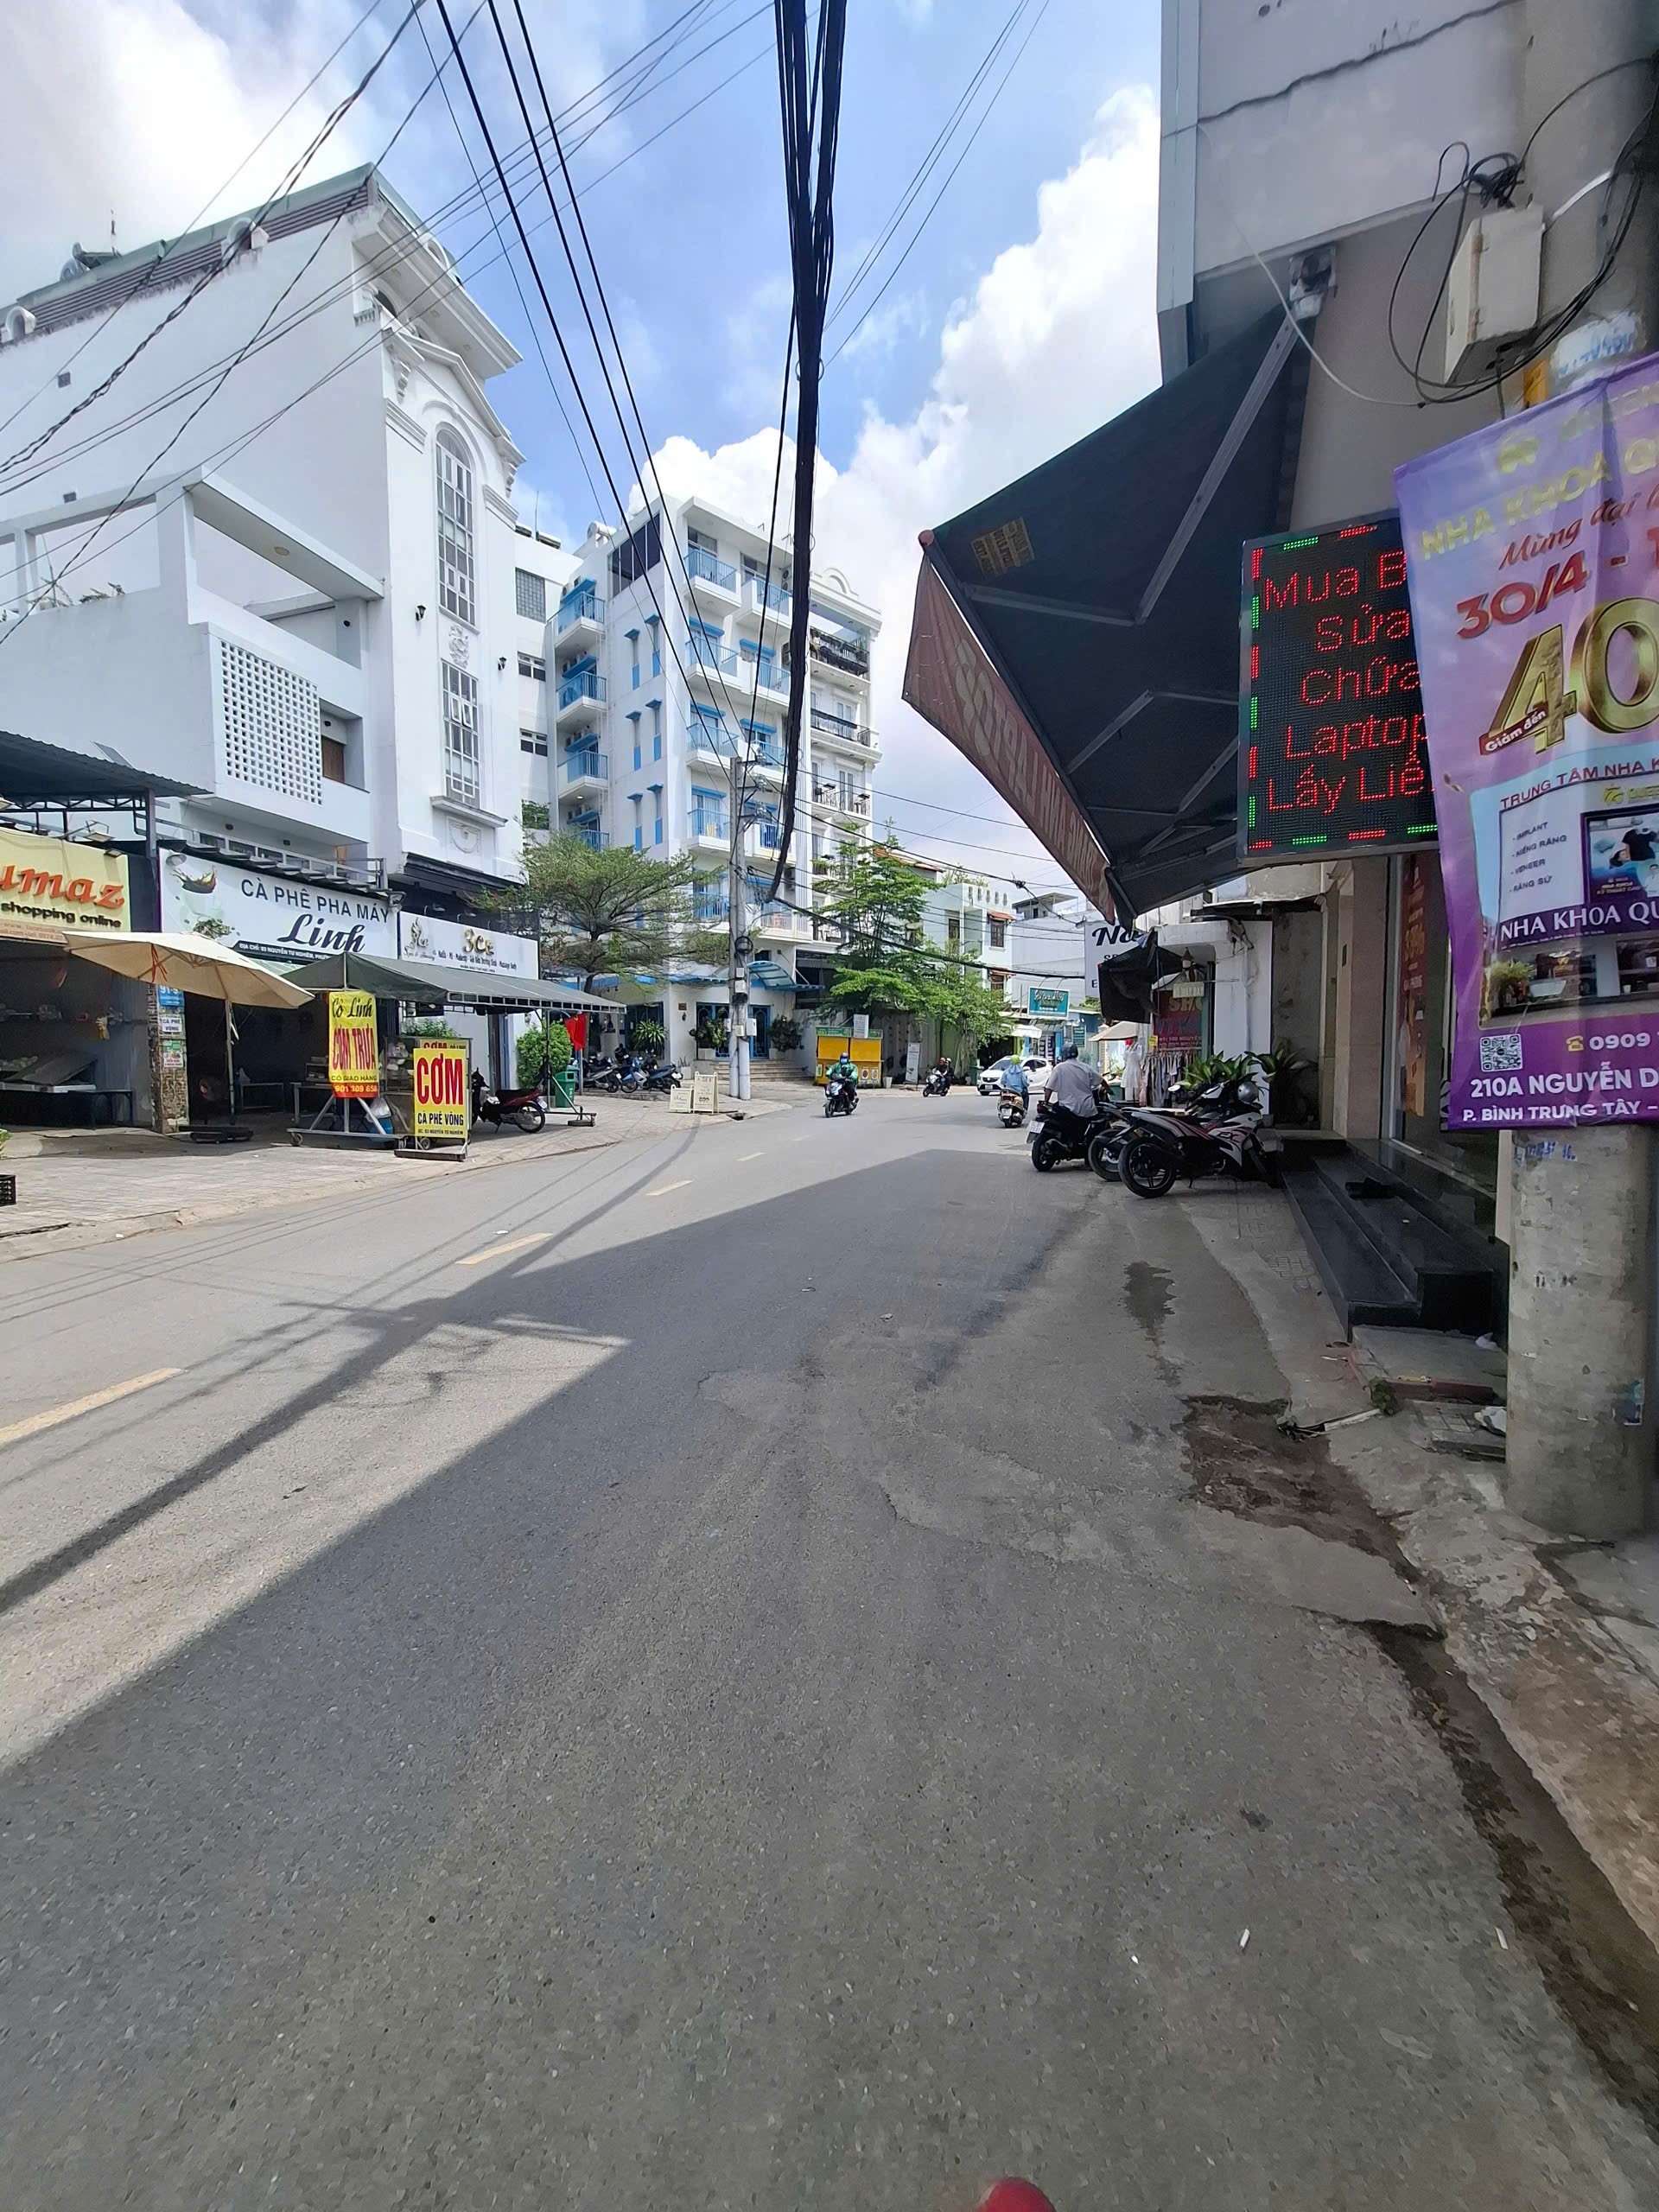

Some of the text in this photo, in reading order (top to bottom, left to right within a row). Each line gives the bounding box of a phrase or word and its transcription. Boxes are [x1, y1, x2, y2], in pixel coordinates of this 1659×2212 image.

[1421, 506, 1496, 560] NHA
[1504, 449, 1612, 525] KHOA
[1498, 518, 1583, 570] Mùng
[1590, 492, 1641, 527] đại
[1264, 566, 1359, 611] Mua
[1456, 550, 1592, 639] 30/4
[1316, 604, 1410, 652] Sửa
[1300, 656, 1422, 706] Chữa
[1485, 710, 1547, 752] Giảm đến
[1268, 763, 1347, 816] Lấy
[1500, 779, 1551, 809] TRUNG
[1557, 766, 1599, 785] TÂM
[1605, 760, 1645, 776] NHA
[1516, 821, 1548, 841] IMPLANT
[1515, 858, 1546, 874] VENEER
[1, 901, 122, 928] shopping online
[241, 877, 390, 924] CÀ PHÊ PHA MÁY
[276, 913, 366, 953] Linh
[1500, 915, 1547, 942] NHA
[1554, 905, 1622, 930] KHOA
[332, 997, 373, 1019] Cô Linh
[332, 1023, 377, 1071] CƠM TRƯA
[1589, 1032, 1651, 1051] 0909
[416, 1052, 464, 1106] CƠM
[1471, 1076, 1523, 1098] 210A
[1529, 1061, 1632, 1095] NGUYỄN
[417, 1109, 427, 1124] CÀ
[429, 1110, 443, 1125] PHÊ
[1463, 1109, 1477, 1122] P.
[1482, 1104, 1523, 1122] BÌNH
[1528, 1103, 1597, 1120] TRƯNG
[1602, 1098, 1641, 1116] TÂY
